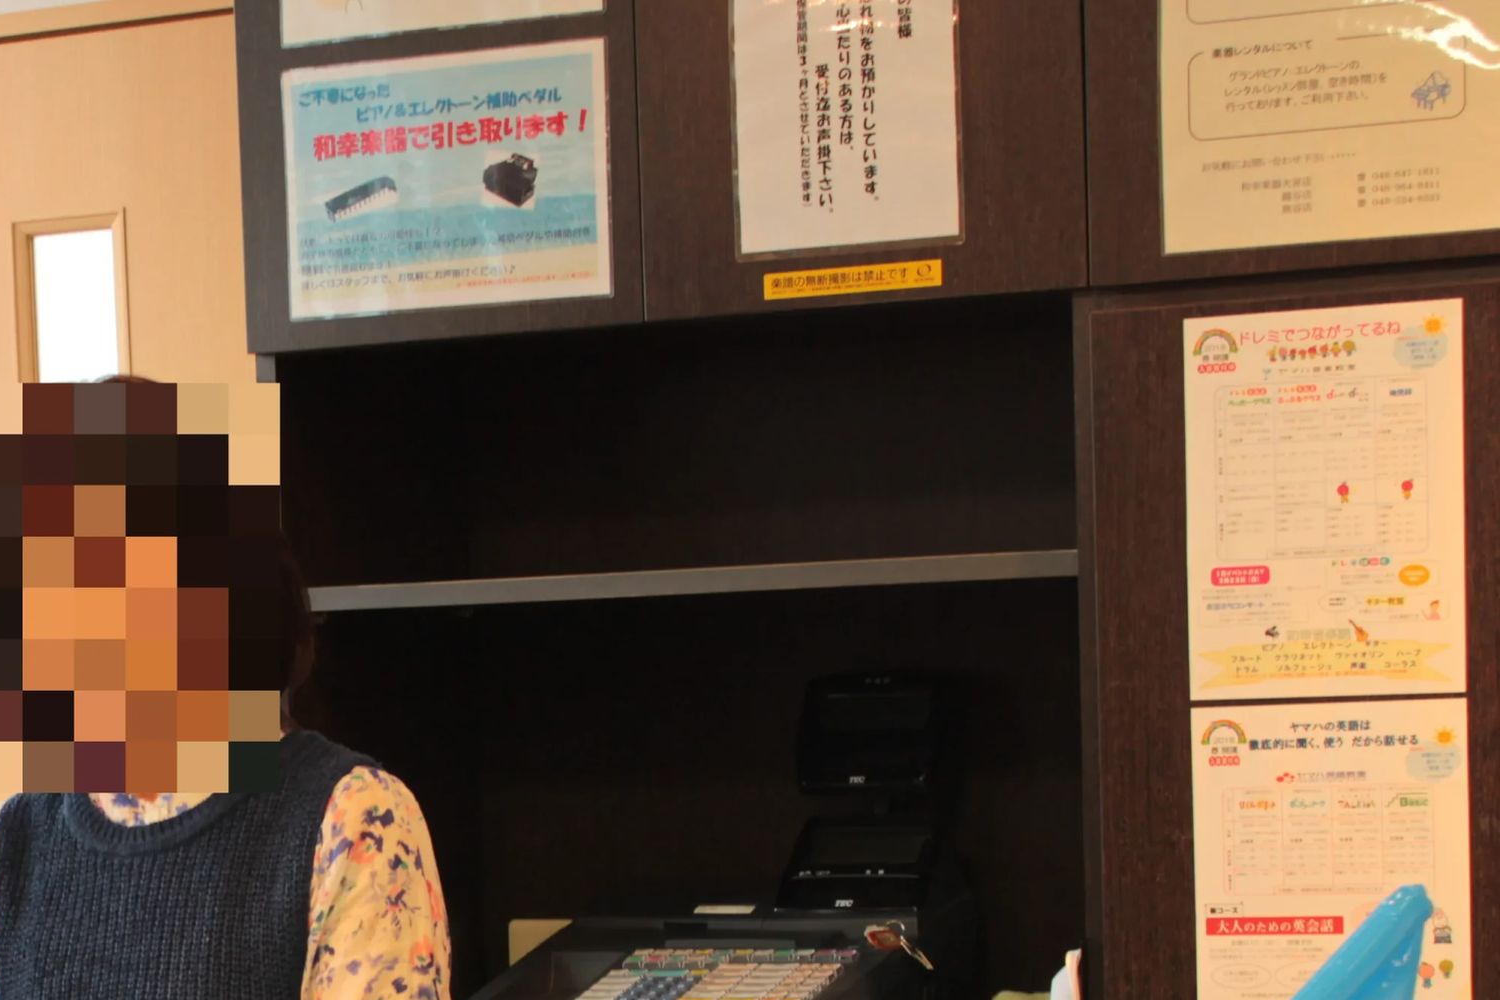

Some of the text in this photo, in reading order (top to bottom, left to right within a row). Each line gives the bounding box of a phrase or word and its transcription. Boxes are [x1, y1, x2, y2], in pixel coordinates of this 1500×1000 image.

[771, 267, 909, 289] 楽譜の無断撮影は禁止です
[1239, 320, 1401, 346] ドレミでつながってるね
[1289, 720, 1371, 733] ヤマハの英語は
[1351, 733, 1420, 748] だから話せる
[1216, 918, 1335, 935] 大人のための英会話
